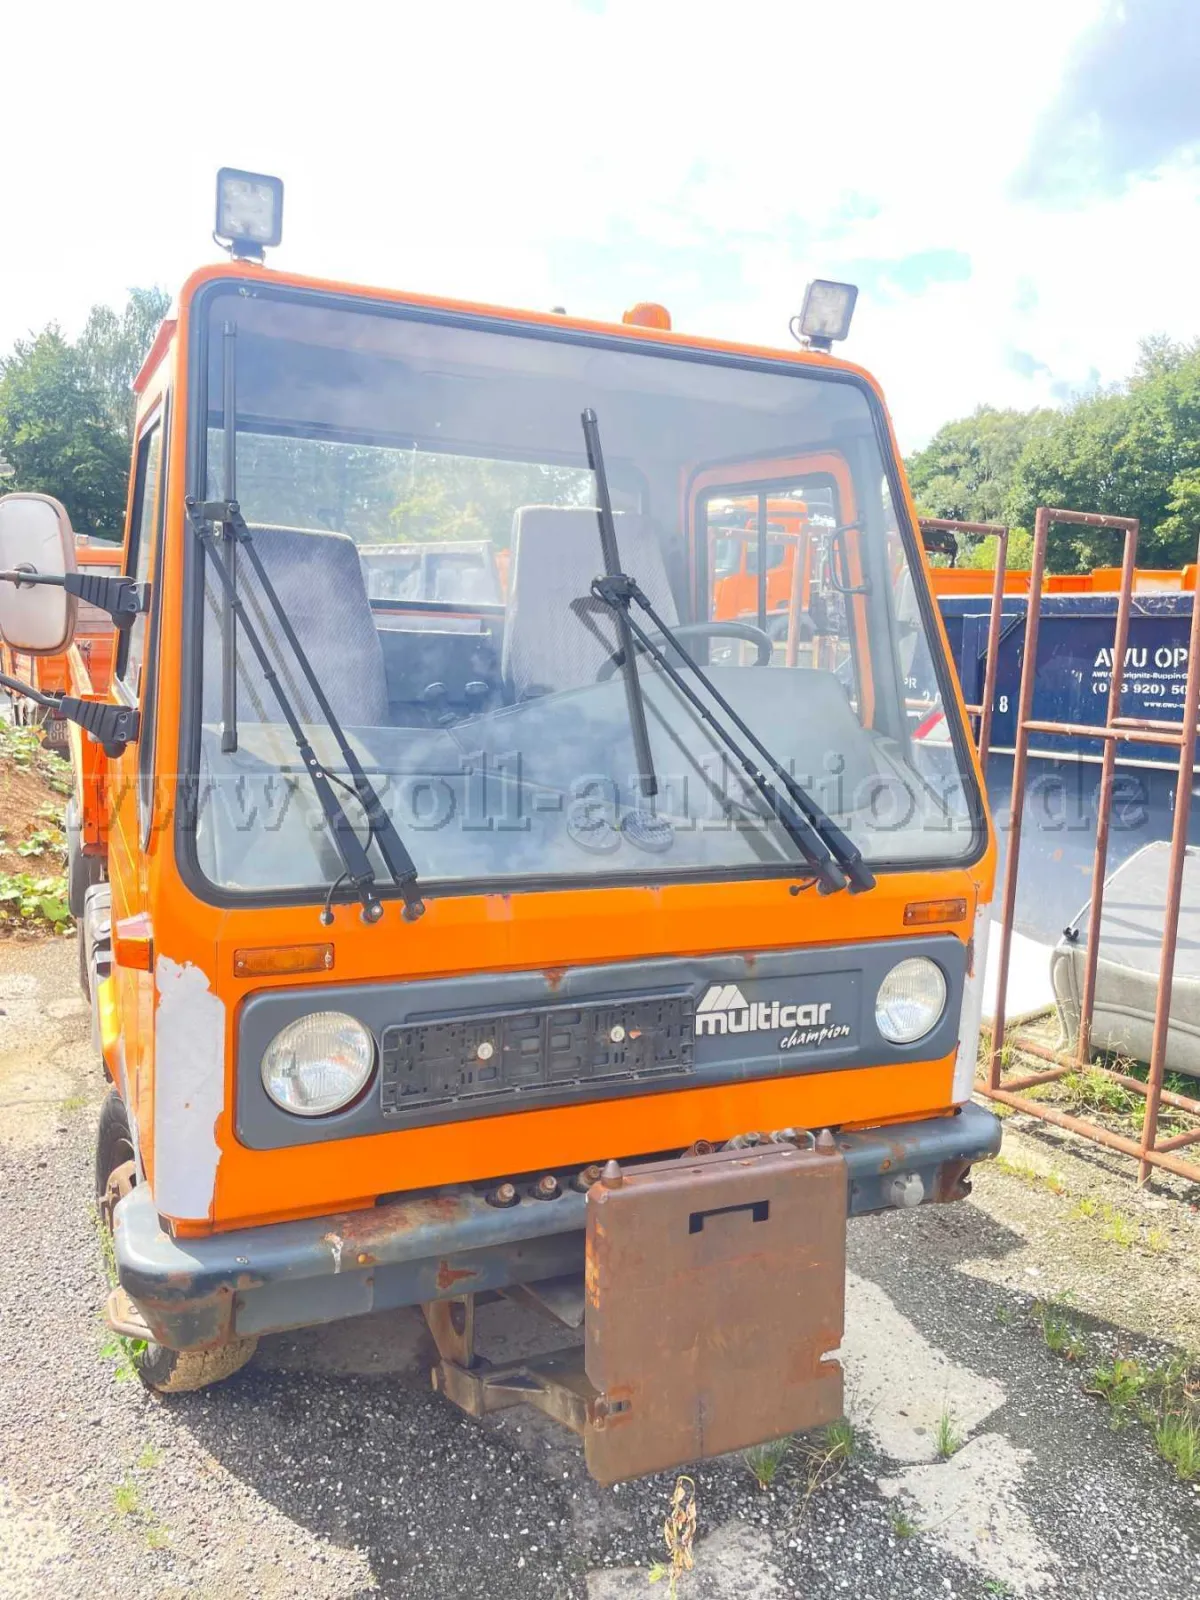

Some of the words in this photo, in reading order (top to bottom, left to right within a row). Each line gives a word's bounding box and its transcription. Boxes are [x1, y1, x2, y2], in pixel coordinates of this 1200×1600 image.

[1155, 648, 1188, 668] OP
[1092, 683, 1128, 695] (03
[695, 1000, 831, 1036] multicar
[779, 1022, 850, 1050] champion
